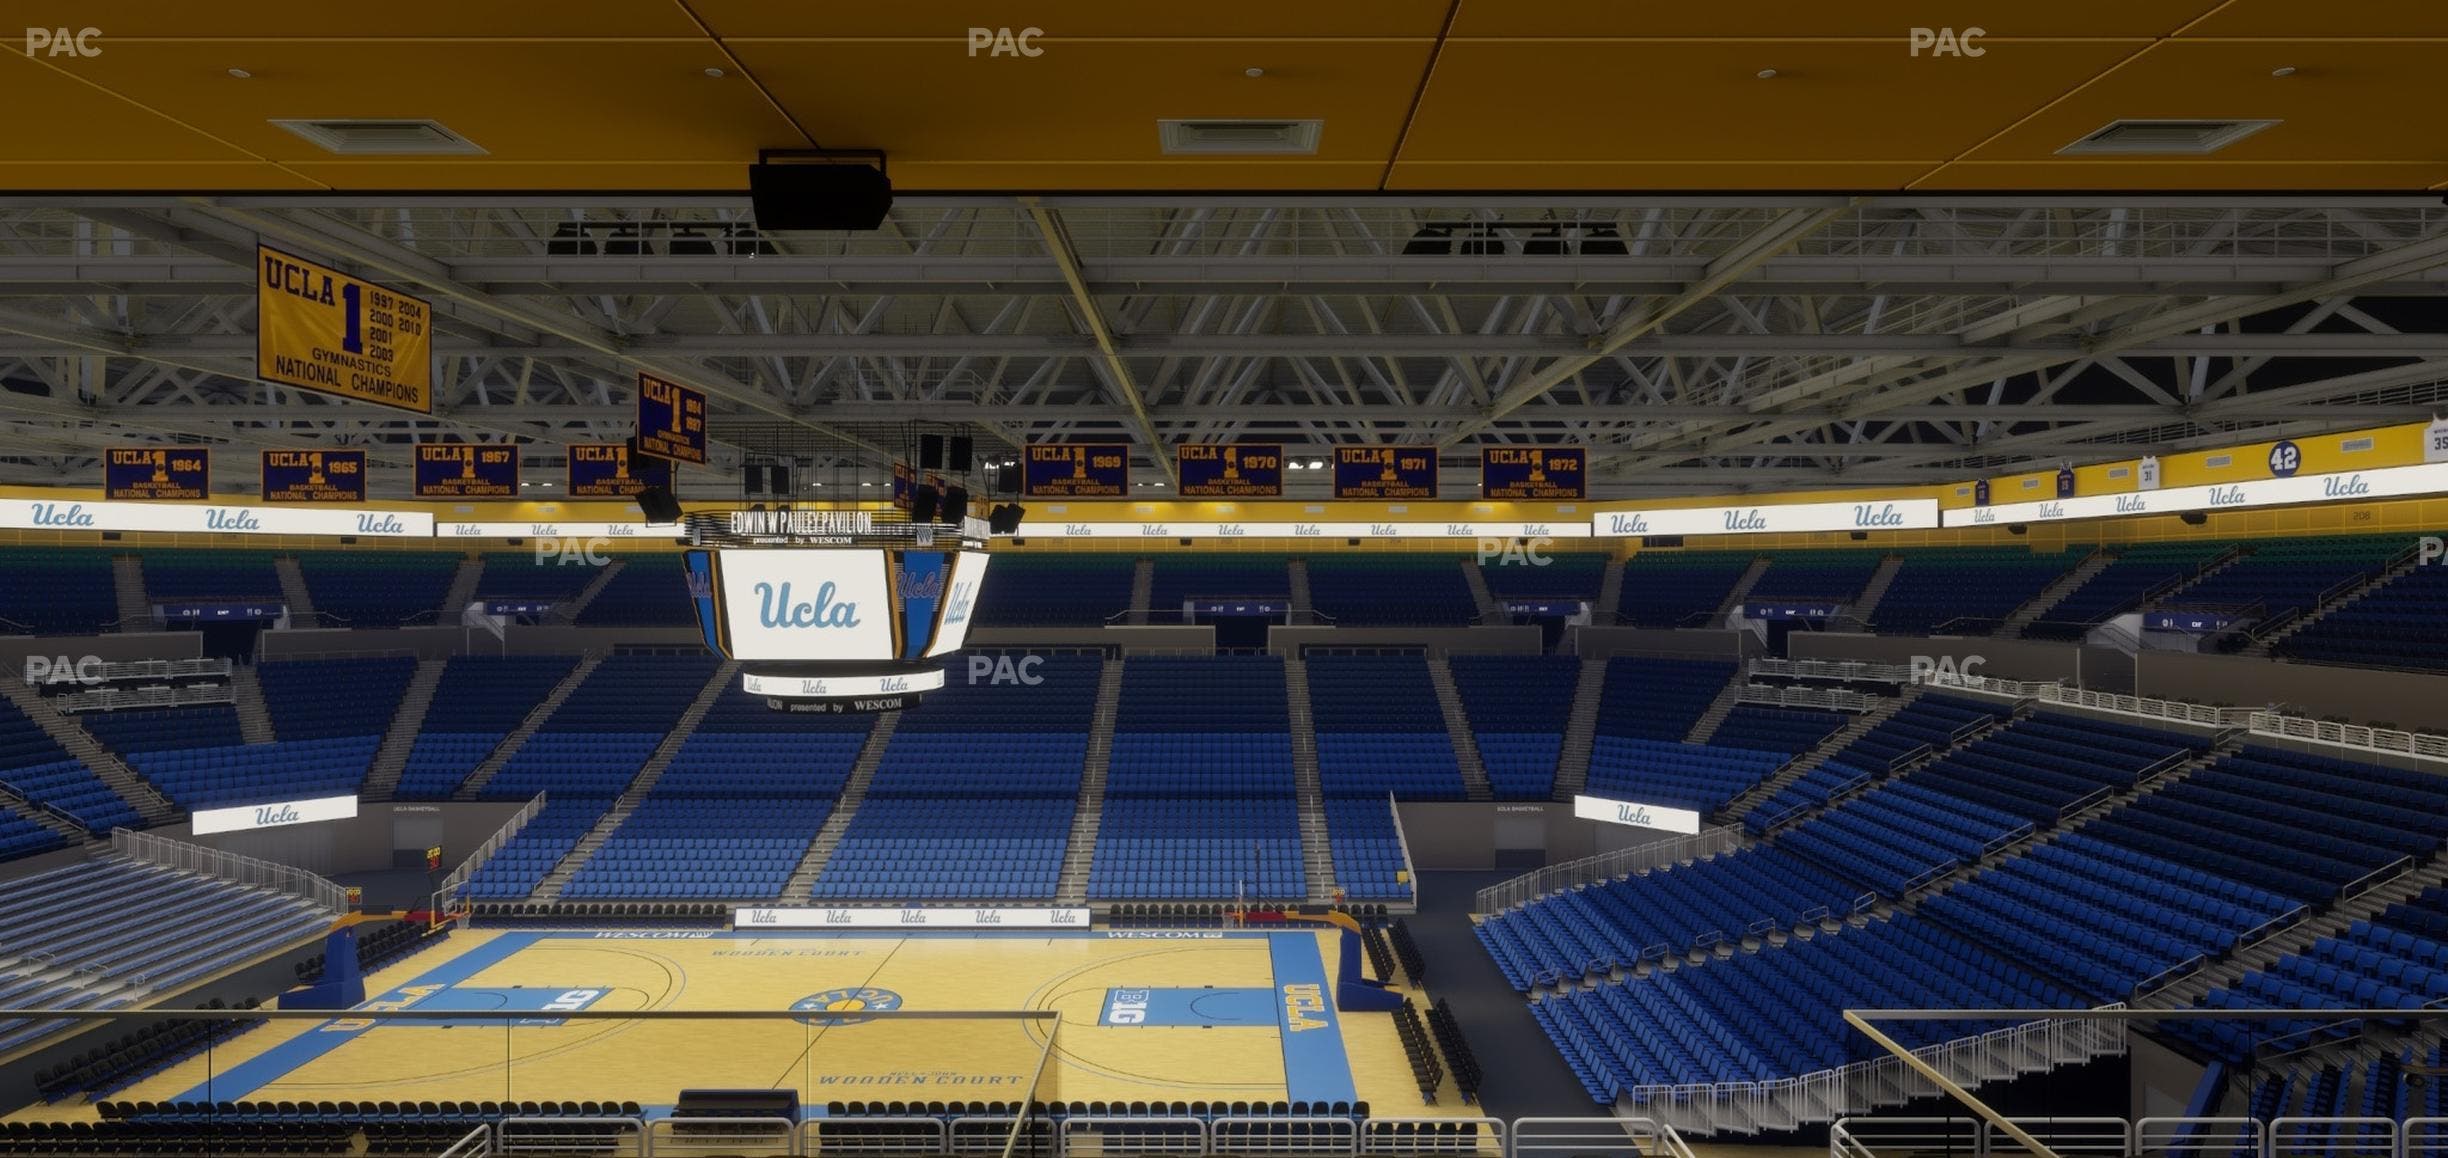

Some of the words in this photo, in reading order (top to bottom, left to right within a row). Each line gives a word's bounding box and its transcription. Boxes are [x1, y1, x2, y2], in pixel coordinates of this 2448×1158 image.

[265, 256, 335, 306] UCLA
[343, 283, 364, 355] 1
[370, 291, 394, 311] 1997
[399, 300, 421, 319] 2004
[370, 309, 394, 328] 2000
[399, 318, 421, 336] 2010
[370, 327, 393, 345] 2001
[312, 347, 391, 378] GYMNASTICS
[370, 345, 394, 362] 2003
[276, 355, 341, 387] NATIONAL
[351, 373, 418, 404] CHAMPIONS
[643, 378, 671, 405] UCLA
[672, 388, 681, 432] 1
[113, 451, 152, 464] UCLA
[152, 451, 168, 481] 1
[172, 459, 202, 471] 1964
[422, 447, 461, 460] UCLA
[462, 447, 476, 478] 1
[481, 451, 510, 463] 1967
[576, 448, 615, 461] UCLA
[616, 447, 629, 478] 1
[1032, 447, 1070, 460] UCLA
[1073, 447, 1087, 478] 1
[1092, 456, 1121, 468] 1969
[1180, 447, 1218, 460] UCLA
[1223, 447, 1239, 478] 1
[1242, 456, 1277, 469] 1970
[1341, 449, 1380, 463] UCLA
[1380, 449, 1397, 481] 1
[1401, 457, 1426, 471] 1971
[1489, 450, 1528, 464] UCLA
[1529, 450, 1546, 481] 1
[1548, 459, 1578, 471] 1972
[2270, 446, 2297, 471] 42
[269, 453, 308, 467] UCLA
[308, 452, 326, 484] 1
[328, 461, 358, 474] 1965
[114, 489, 150, 498] NATIONAL
[155, 489, 201, 498] CHAMPIONS
[423, 485, 460, 494] NATIONAL
[465, 485, 510, 494] CHAMPIONS
[576, 486, 613, 494] NATIONAL
[1033, 485, 1069, 494] NATIONAL
[1075, 485, 1120, 494] CHAMPIONS
[1184, 485, 1224, 495] NATIONAL
[1226, 485, 1277, 495] CHAMPIONS
[1342, 488, 1379, 497] NATIONAL
[1384, 488, 1430, 497] CHAMPIONS
[1490, 488, 1527, 497] NATIONAL
[1533, 488, 1577, 497] CHAMPIONS
[2324, 474, 2369, 497] Ucla
[270, 491, 307, 500] NATIONAL
[313, 491, 357, 500] CHAMPIONS
[2116, 494, 2145, 512] Ucla
[2208, 485, 2245, 505] Ucla
[32, 503, 94, 526] Ucla
[1855, 504, 1903, 526] Ucla
[1974, 508, 1995, 523] Ucla
[2039, 502, 2064, 518] Ucla
[206, 509, 260, 530] Ucla
[357, 513, 404, 533] Ucla
[731, 511, 765, 533] EDWIN
[768, 511, 778, 533] W
[780, 511, 819, 533] PAULEY
[823, 511, 871, 533] PAVILION
[1611, 514, 1648, 533] Ucla
[1724, 509, 1767, 530] Ucla
[455, 524, 481, 535] Ucla
[532, 524, 557, 535] Ucla
[608, 524, 634, 535] Ucla
[1066, 524, 1091, 535] Ucla
[1142, 524, 1167, 535] Ucla
[1218, 524, 1243, 535] Ucla
[1295, 524, 1320, 535] Ucla
[1371, 524, 1396, 535] Ucla
[1448, 524, 1473, 535] Ucla
[1524, 524, 1549, 535] Ucla
[753, 536, 788, 544] presented
[796, 536, 804, 544] by
[810, 536, 852, 544] WESCOM
[897, 571, 941, 599] Ucla
[754, 581, 861, 628] Ucla
[945, 582, 972, 625] Ucla
[802, 680, 827, 694] Ucla
[880, 677, 908, 692] Ucla
[790, 703, 827, 713] presented
[833, 704, 844, 713] by
[854, 698, 902, 711] WESCOM
[255, 805, 299, 826] Ucla
[1617, 804, 1652, 825] Ucla
[752, 910, 777, 923] Ucla
[827, 910, 852, 923] Ucla
[901, 910, 926, 923] Ucla
[976, 910, 1001, 923] Ucla
[1050, 910, 1075, 923] Ucla
[1283, 983, 1329, 1032] UCLA
[819, 1075, 931, 1084] WOODEN
[936, 1075, 1024, 1084] COURT
